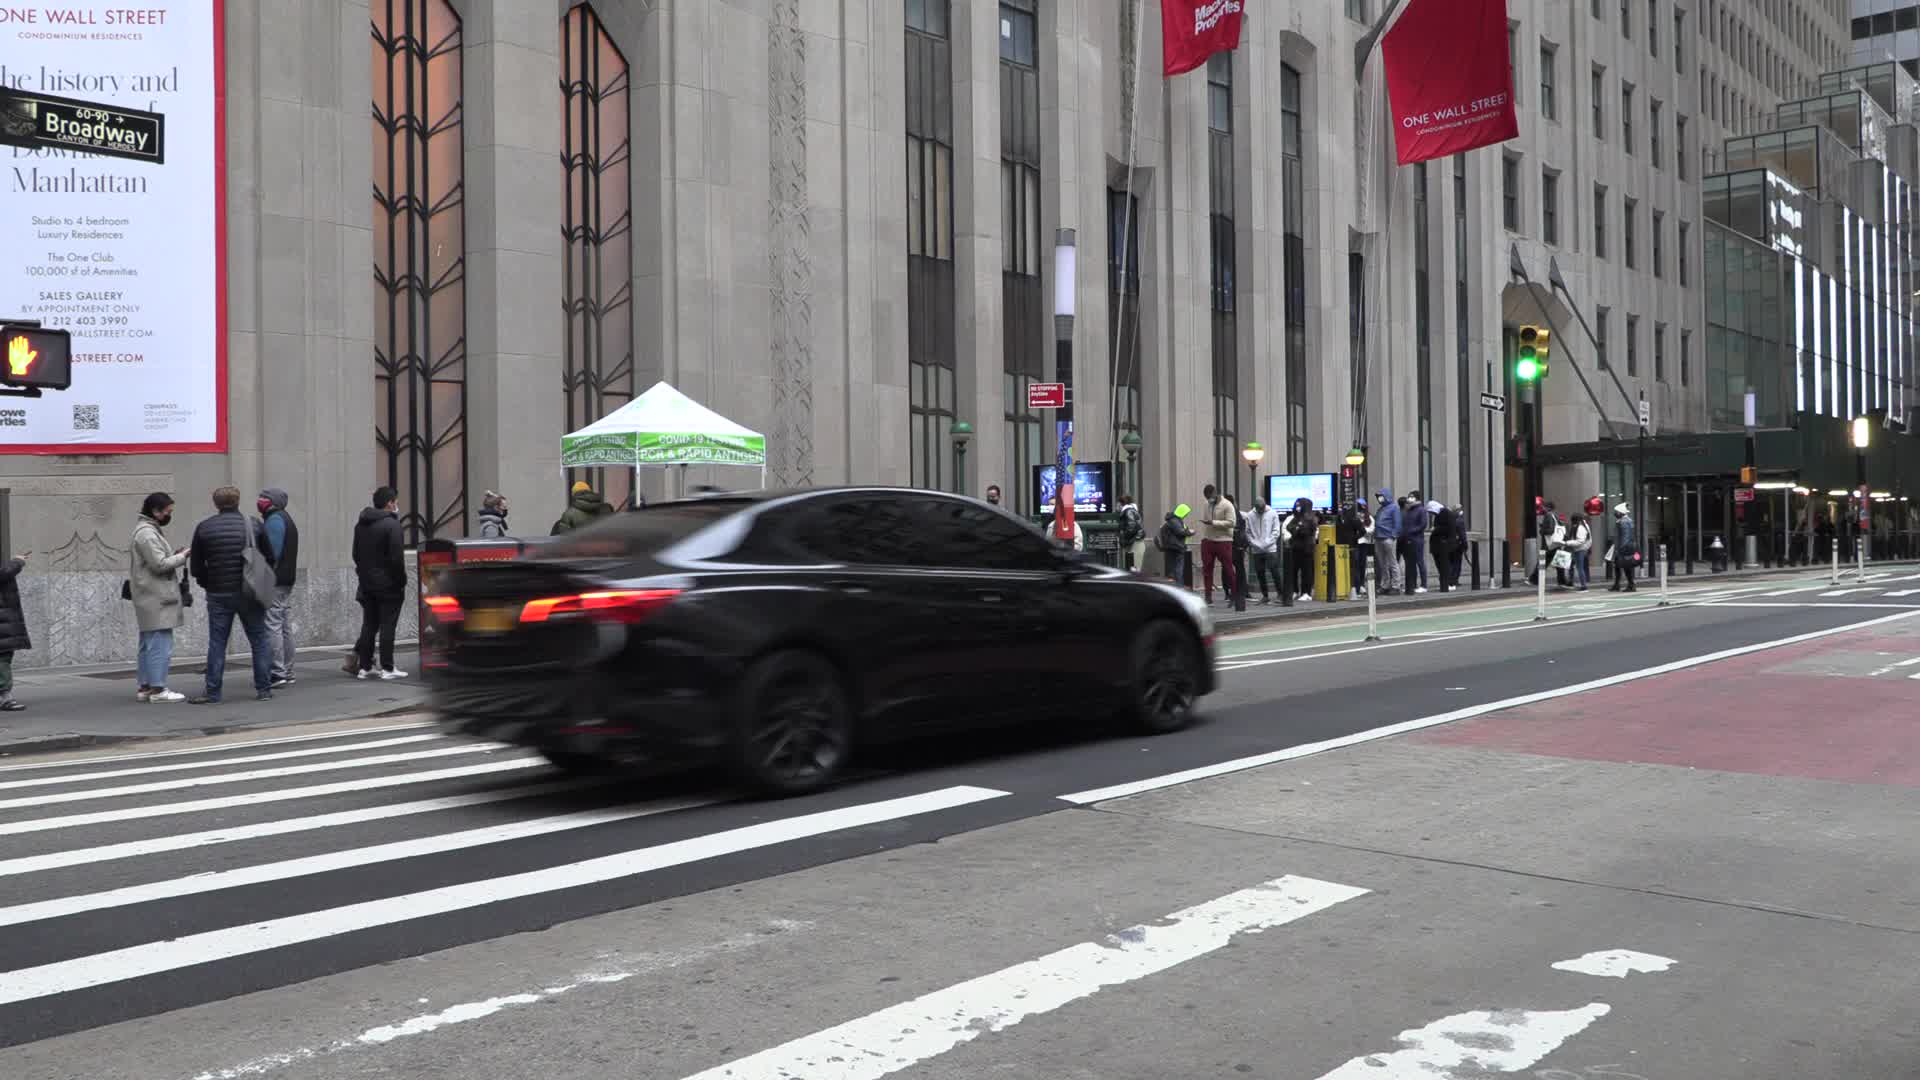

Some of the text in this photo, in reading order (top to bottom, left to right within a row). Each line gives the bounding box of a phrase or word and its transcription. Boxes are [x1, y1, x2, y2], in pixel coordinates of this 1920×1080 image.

[0, 9, 167, 25] ONE WALL STREET
[17, 31, 143, 41] CONDOMINIUM RESIDENCES
[41, 66, 122, 96] history
[131, 67, 179, 92] and
[76, 109, 110, 123] 60-90
[1402, 113, 1430, 128] ONE
[1433, 104, 1468, 120] WALL
[45, 112, 149, 150] Broadway
[56, 133, 89, 145] CANYON
[11, 167, 148, 193] Manhattan
[31, 215, 130, 226] Studio to 4 bedroom
[37, 229, 124, 241] Luxury Residences
[47, 252, 115, 262] The One Club
[24, 266, 138, 277] 100,000 sf of Amenities
[39, 291, 124, 301] SALES GALLERY
[21, 304, 141, 313] BY APPOINTMENT ONLY
[53, 316, 72, 326] 212
[76, 316, 97, 326] 403
[101, 316, 129, 326] 3990
[678, 446, 712, 460] RAPID
